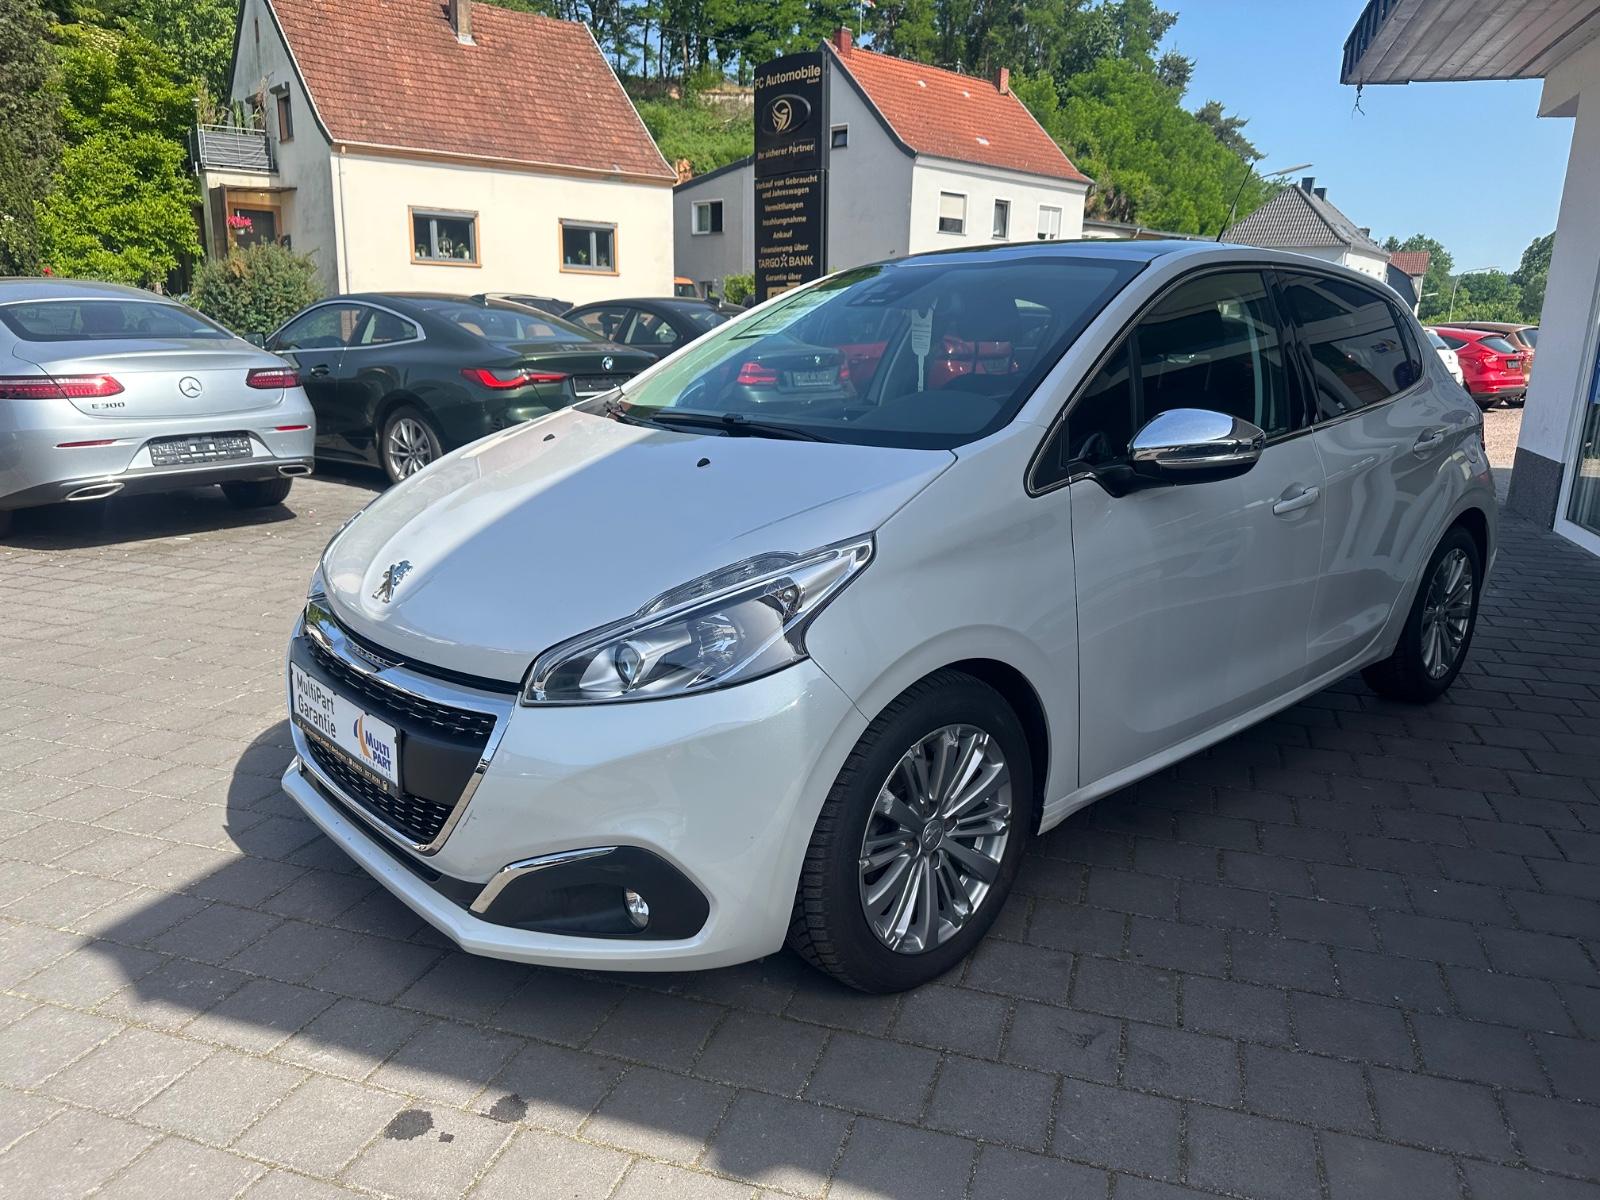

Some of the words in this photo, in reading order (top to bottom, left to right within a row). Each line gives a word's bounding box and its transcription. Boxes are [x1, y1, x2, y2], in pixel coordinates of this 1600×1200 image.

[755, 76, 764, 90] FC
[766, 65, 821, 87] Automobile
[765, 147, 787, 158] sicherer
[788, 143, 814, 154] Partner
[774, 179, 785, 187] von
[785, 174, 817, 185] Gebraucht
[772, 187, 810, 197] Jahreswagen
[773, 229, 793, 239] Ankauf
[296, 671, 335, 715] MultiPart
[298, 694, 336, 738] Garantie
[372, 750, 391, 771] PART
